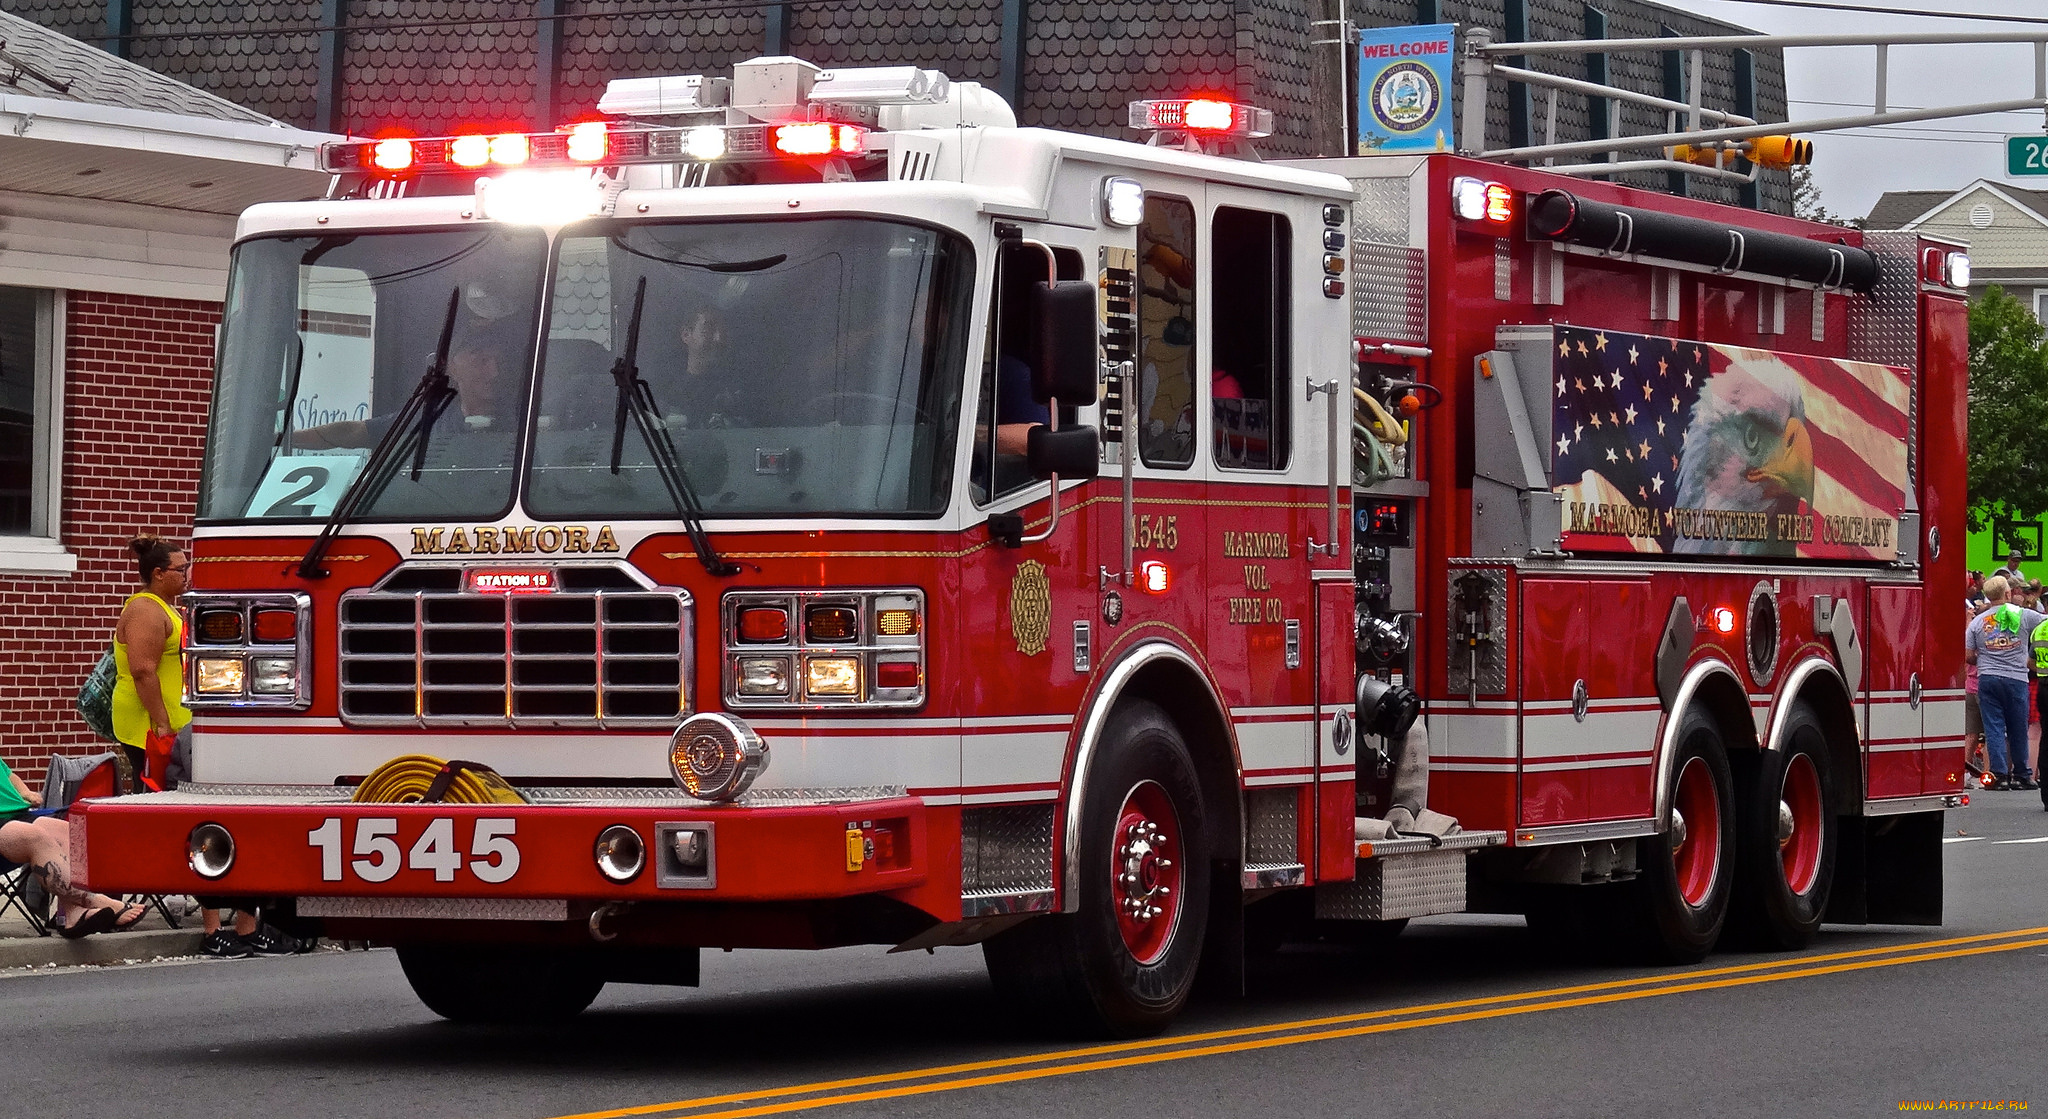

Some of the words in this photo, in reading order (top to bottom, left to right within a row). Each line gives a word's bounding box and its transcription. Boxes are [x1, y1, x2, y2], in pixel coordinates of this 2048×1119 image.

[1363, 41, 1449, 58] WELCOME
[262, 466, 330, 516] 2
[1570, 502, 1662, 538] MARMORA
[1672, 508, 1769, 541] VOLUNTEER
[1776, 513, 1814, 542] FIRE
[1822, 515, 1892, 547] COMPANY
[411, 525, 620, 554] MARMORA
[1224, 531, 1289, 558] MARMORA
[477, 575, 530, 586] STATION
[533, 575, 548, 586] 15
[1244, 565, 1271, 591] VOL.
[1229, 598, 1262, 624] FIRE
[308, 818, 521, 883] 1545
